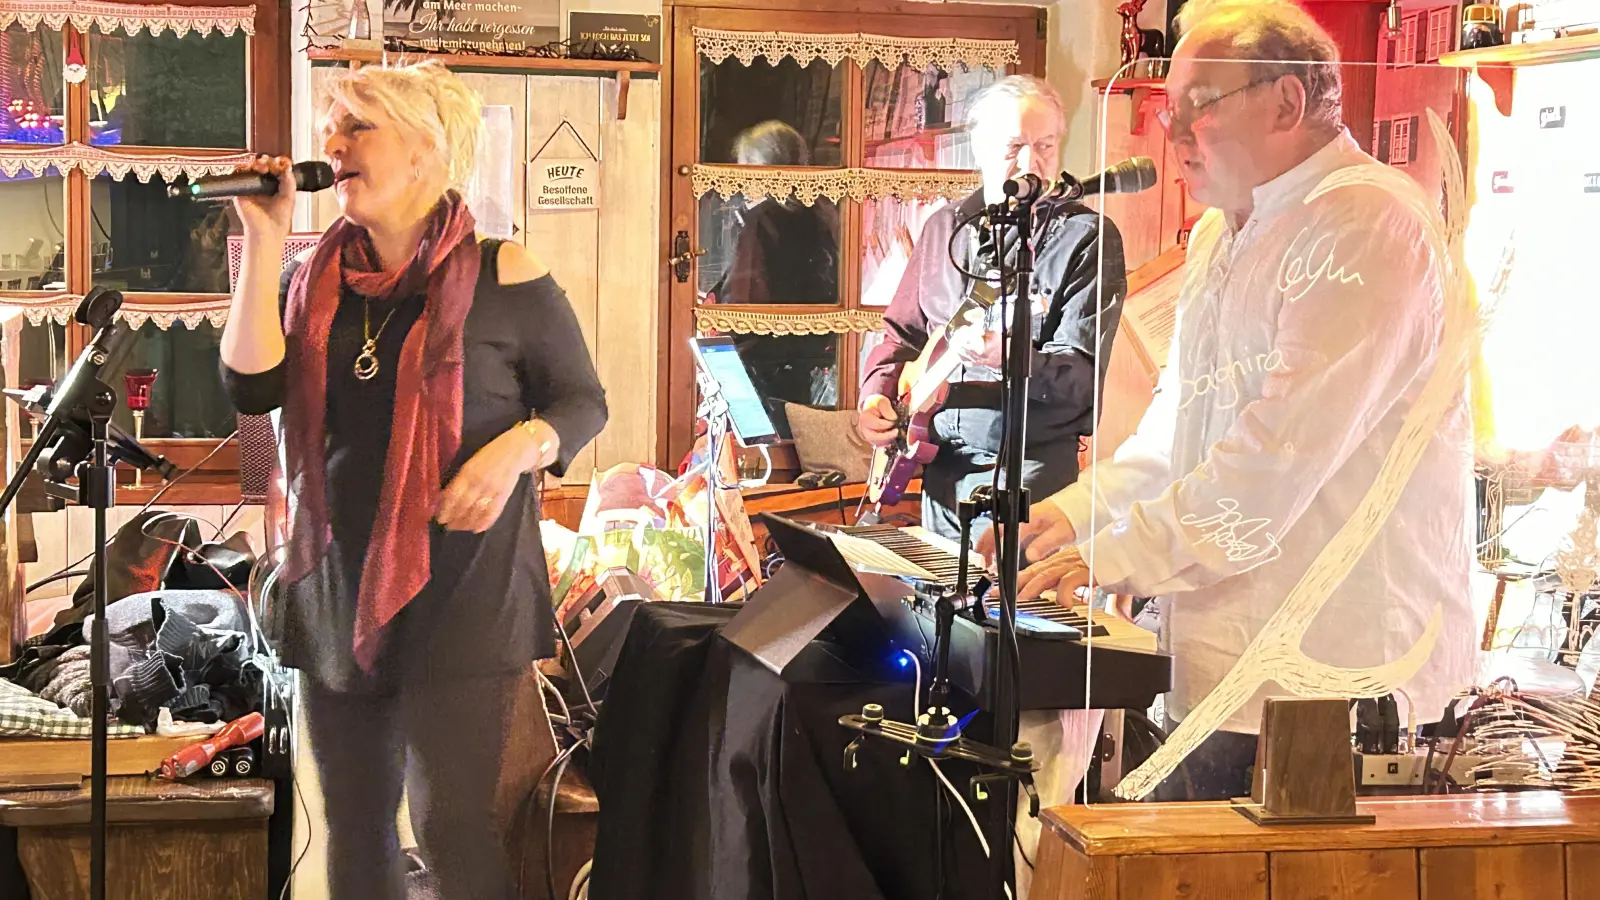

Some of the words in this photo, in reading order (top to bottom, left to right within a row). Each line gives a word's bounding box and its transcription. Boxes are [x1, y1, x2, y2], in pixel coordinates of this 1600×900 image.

[422, 1, 441, 11] am
[443, 1, 471, 12] Meer
[409, 12, 444, 34] Ihr
[446, 16, 477, 33] habt
[479, 23, 536, 40] vergessen
[547, 165, 585, 179] HEUTE
[542, 185, 588, 195] Besoffene
[538, 195, 594, 206] Gesellschaft
